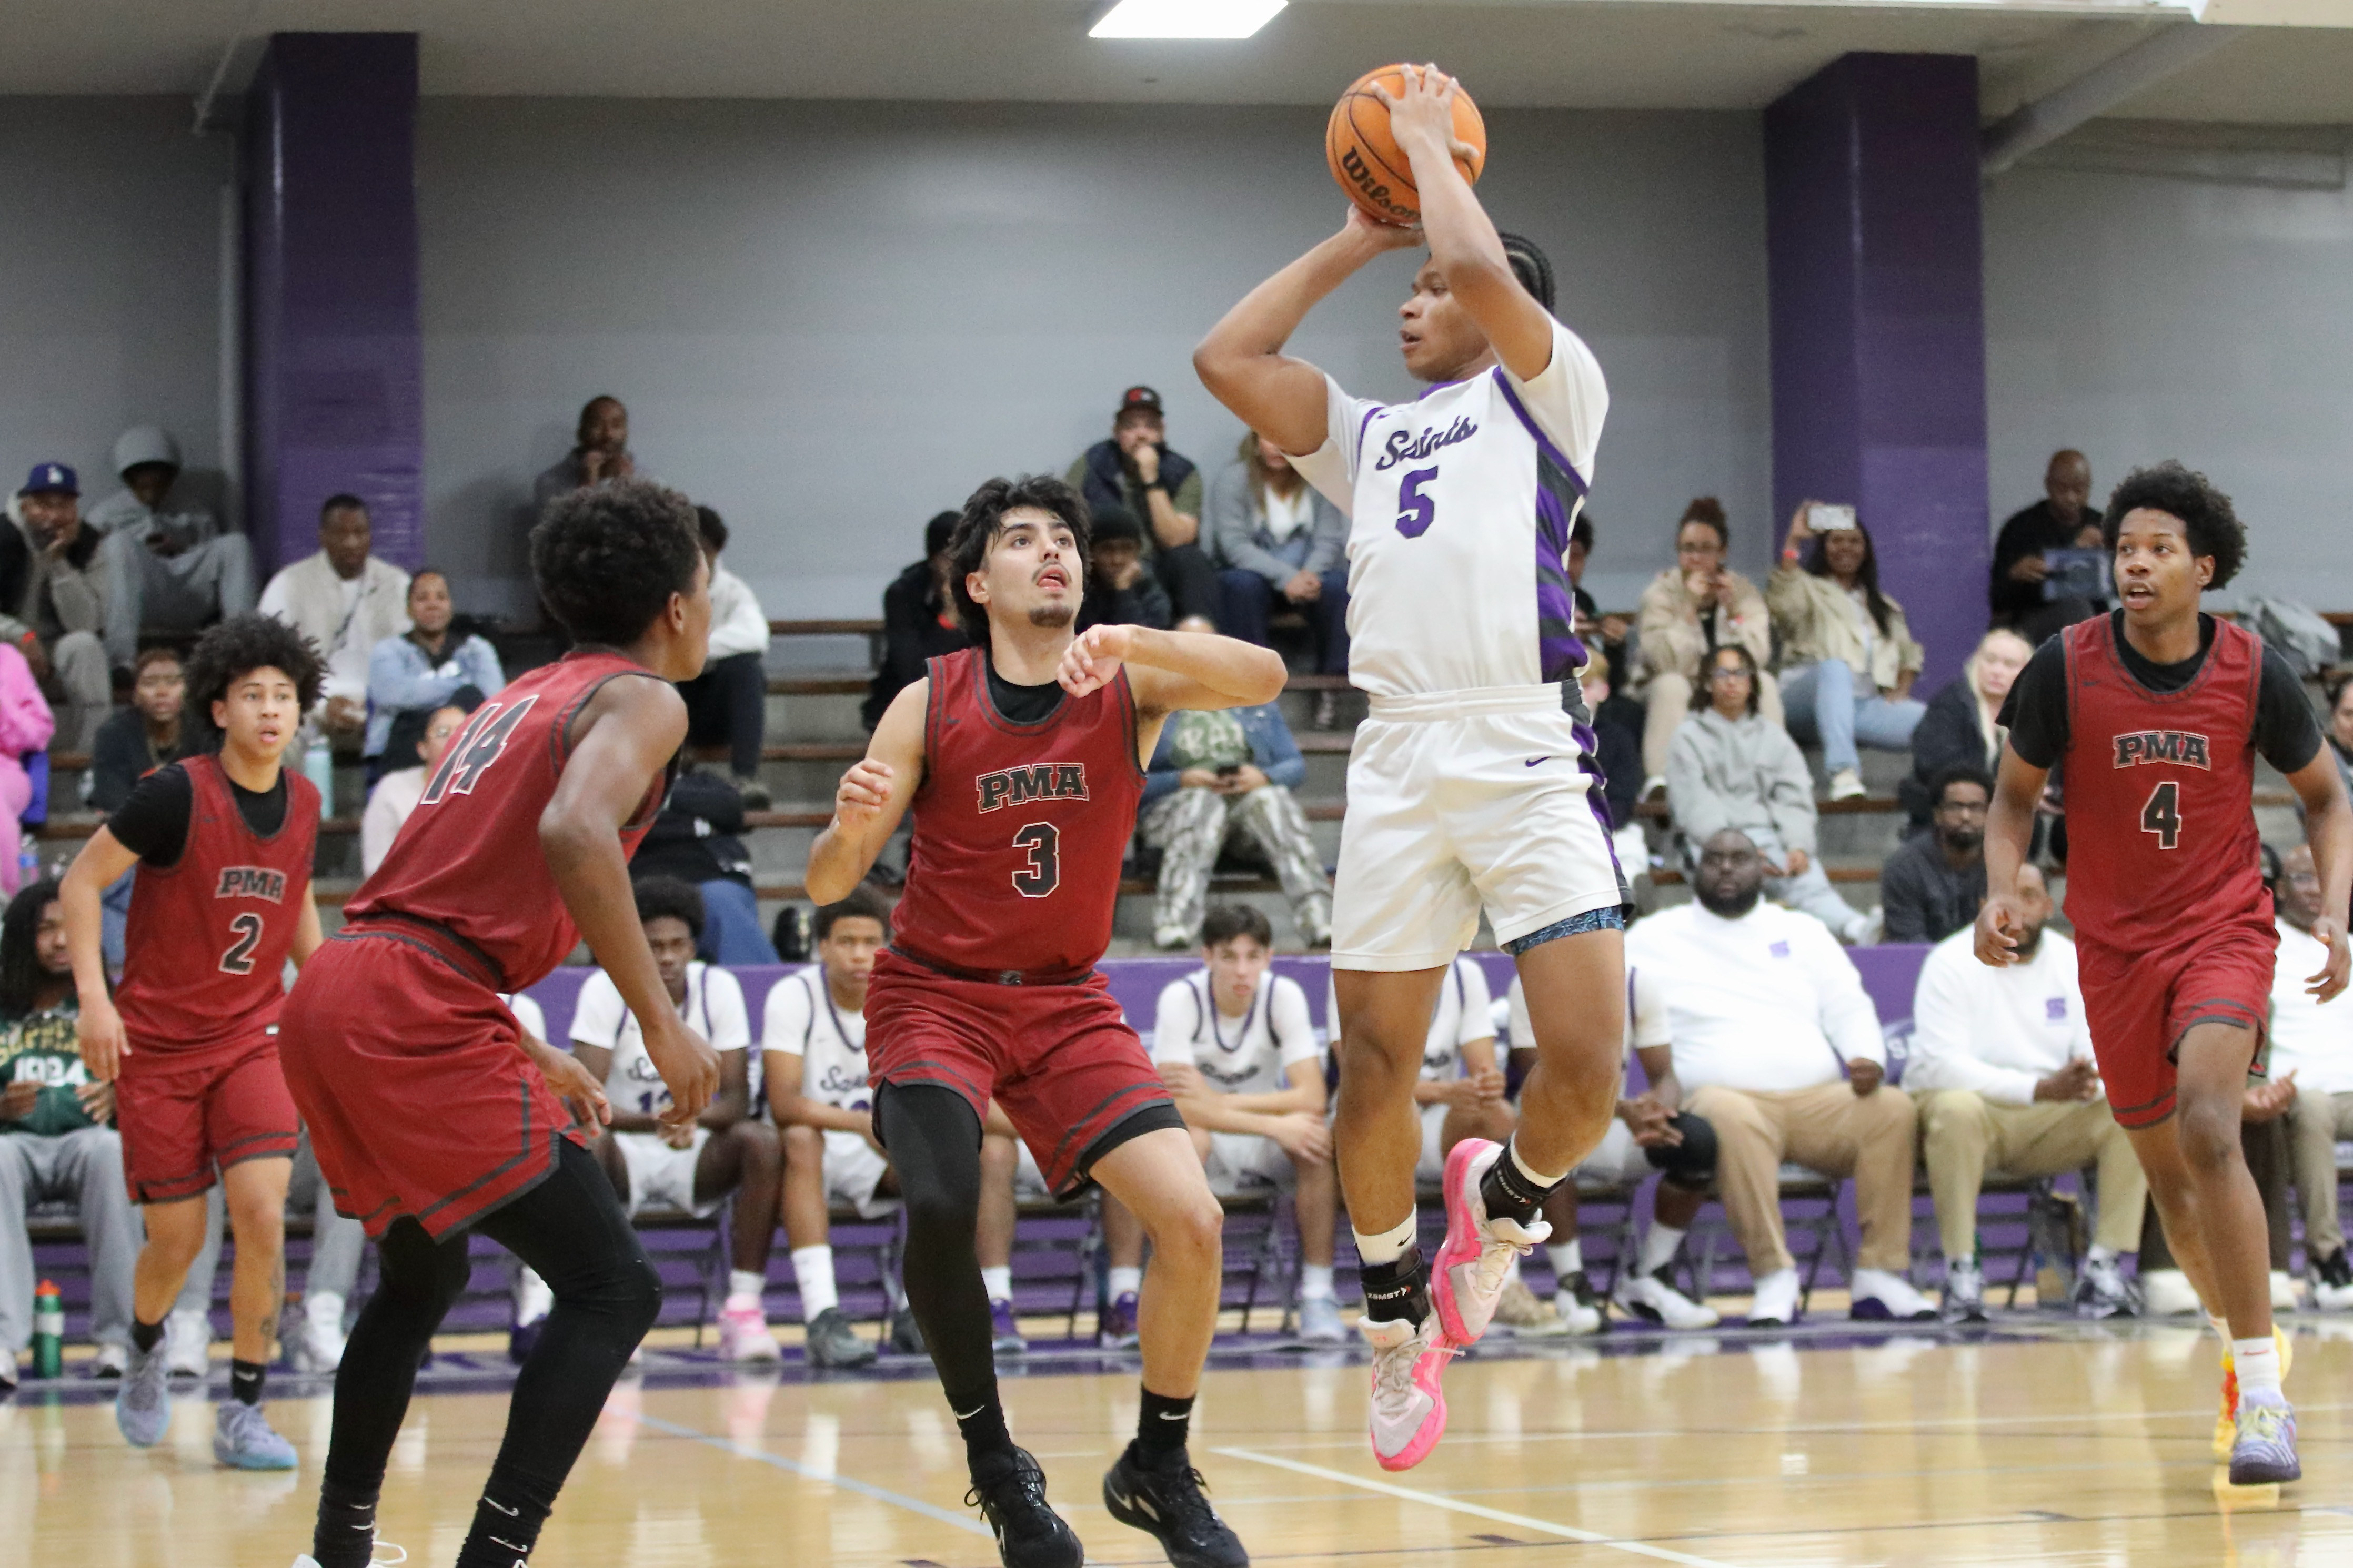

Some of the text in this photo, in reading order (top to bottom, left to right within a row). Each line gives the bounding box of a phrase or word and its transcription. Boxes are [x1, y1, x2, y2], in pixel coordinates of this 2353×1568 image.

[1375, 415, 1477, 471] Saints
[1395, 465, 1439, 539] 5
[420, 694, 540, 805] 14
[2113, 731, 2211, 771] PMA
[976, 763, 1089, 814] PMA
[2141, 782, 2182, 849] 4
[215, 866, 287, 904] PMA
[1012, 822, 1059, 898] 3
[218, 912, 265, 975] 2
